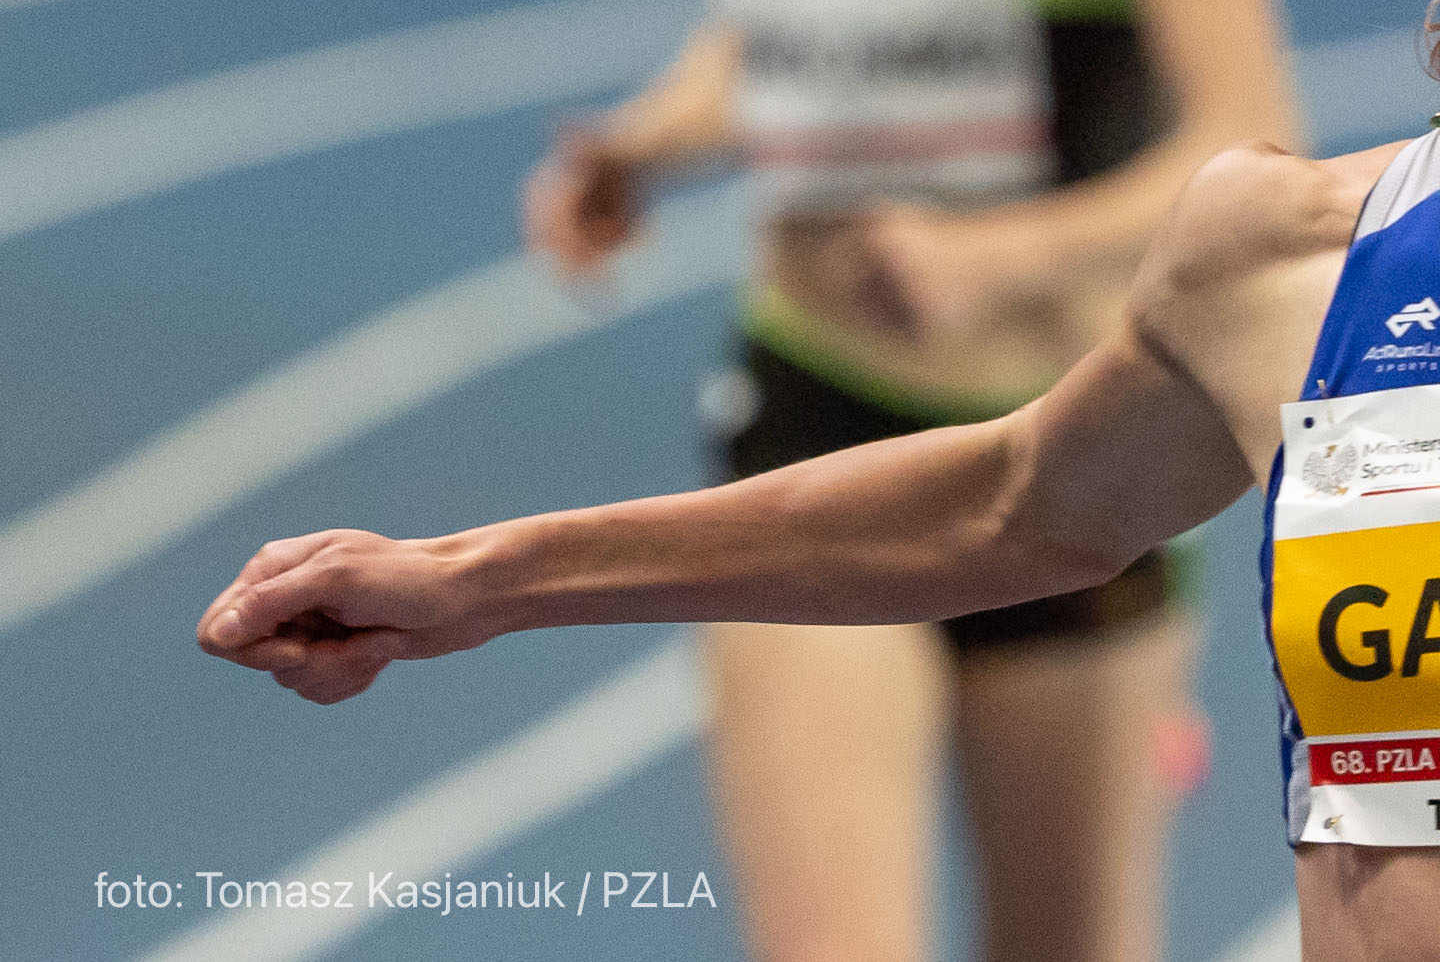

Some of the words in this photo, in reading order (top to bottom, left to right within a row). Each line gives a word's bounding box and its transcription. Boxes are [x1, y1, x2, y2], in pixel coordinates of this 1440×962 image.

[1375, 362, 1438, 373] SPORTS
[1360, 461, 1423, 479] Sportu
[1330, 749, 1373, 776] 68.
[1375, 746, 1436, 773] PZLA
